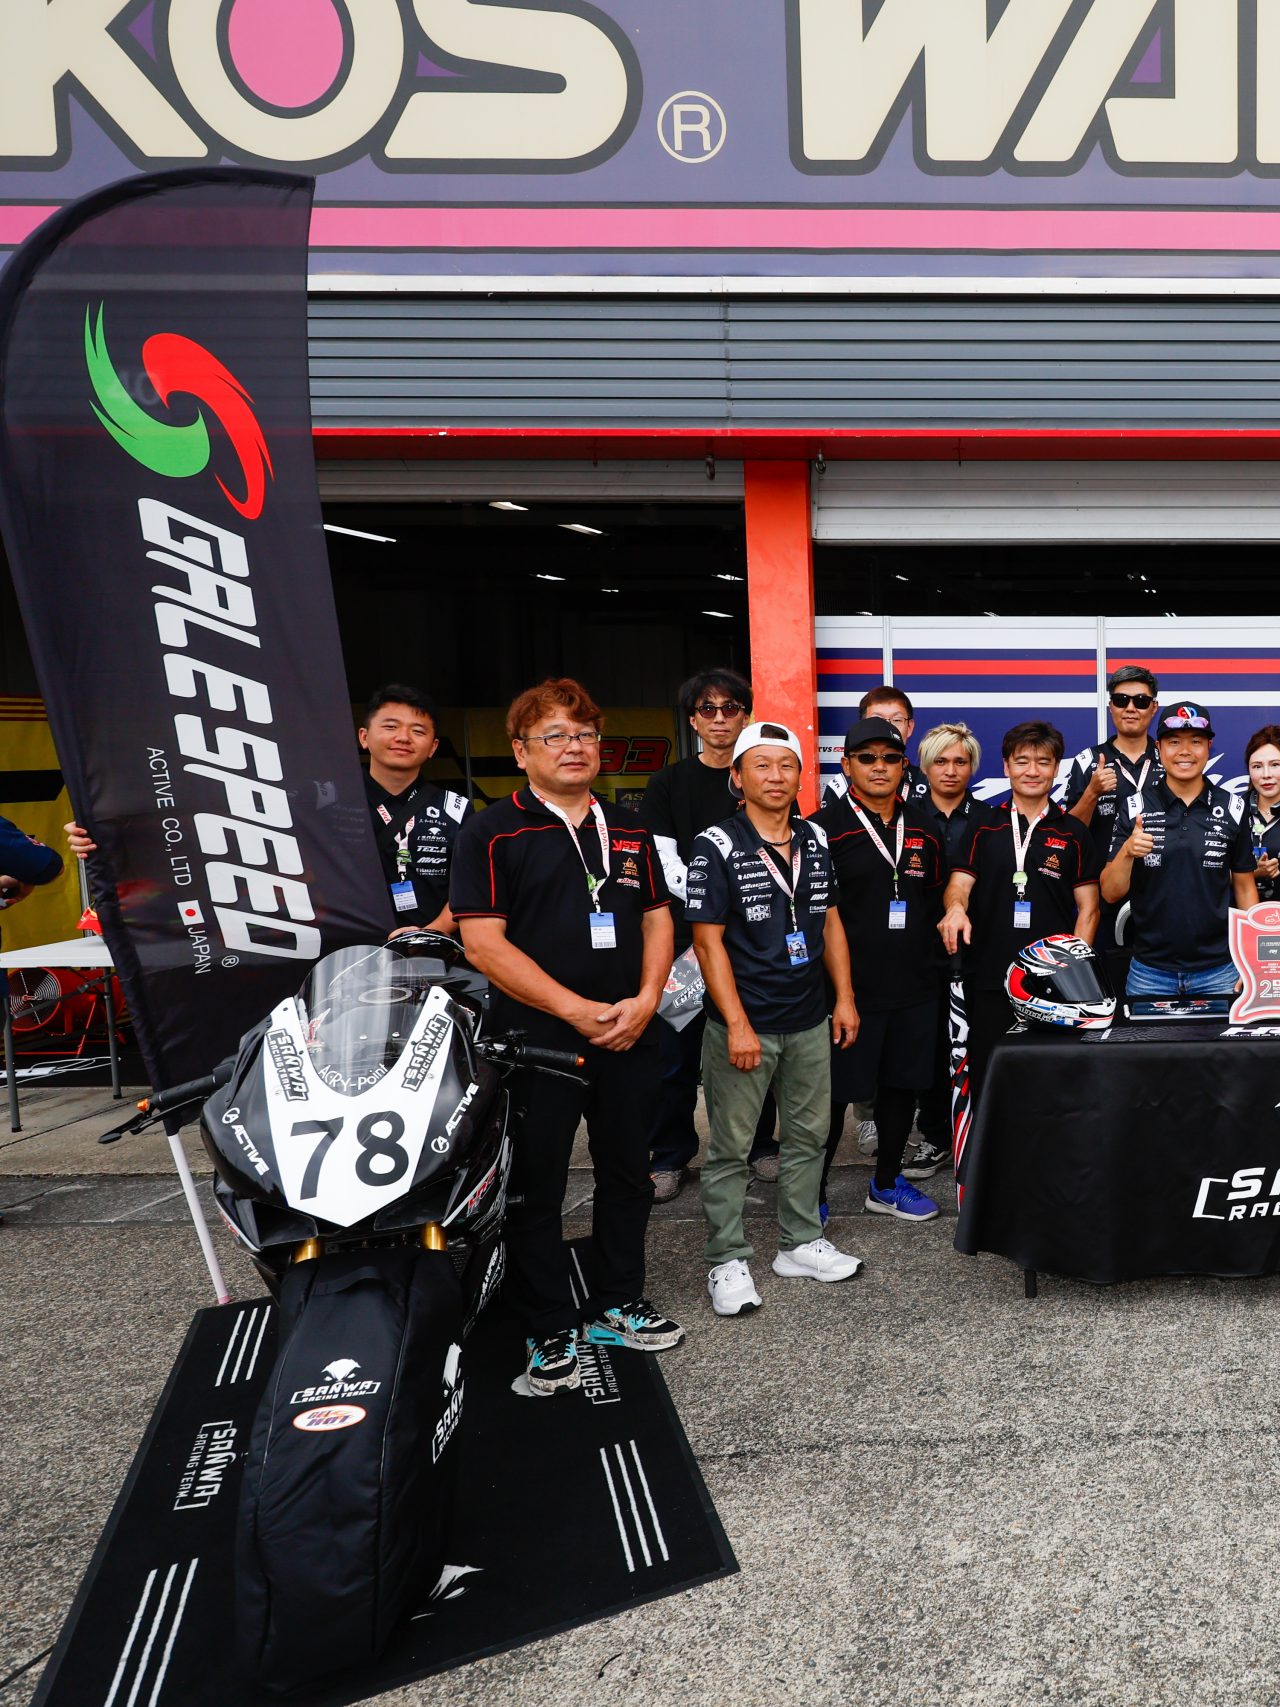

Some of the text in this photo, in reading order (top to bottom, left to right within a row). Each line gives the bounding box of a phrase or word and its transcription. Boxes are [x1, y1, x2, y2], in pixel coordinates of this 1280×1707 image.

[146, 746, 176, 808] ACTIVE
[169, 856, 192, 887] LTD
[904, 837, 924, 848] YSS
[1044, 836, 1068, 848] YSS
[612, 839, 641, 852] YSS
[187, 923, 212, 974] JAPAN
[1259, 979, 1272, 998] 2
[270, 1039, 292, 1091] RACING TEAM
[276, 1033, 309, 1094] SANWA
[404, 1018, 442, 1080] SANWA
[416, 1026, 448, 1081] RACING TEAM
[445, 1082, 480, 1137] ACTIVE
[231, 1124, 270, 1177] ACTIVE
[290, 1110, 410, 1201] 78
[301, 1380, 374, 1399] SANWA
[301, 1389, 367, 1403] RACING TEAM
[602, 1364, 620, 1393] RACING
[435, 1379, 466, 1442] SANW
[175, 1433, 209, 1498] RACING TEAM
[192, 1427, 238, 1498] SANWA
